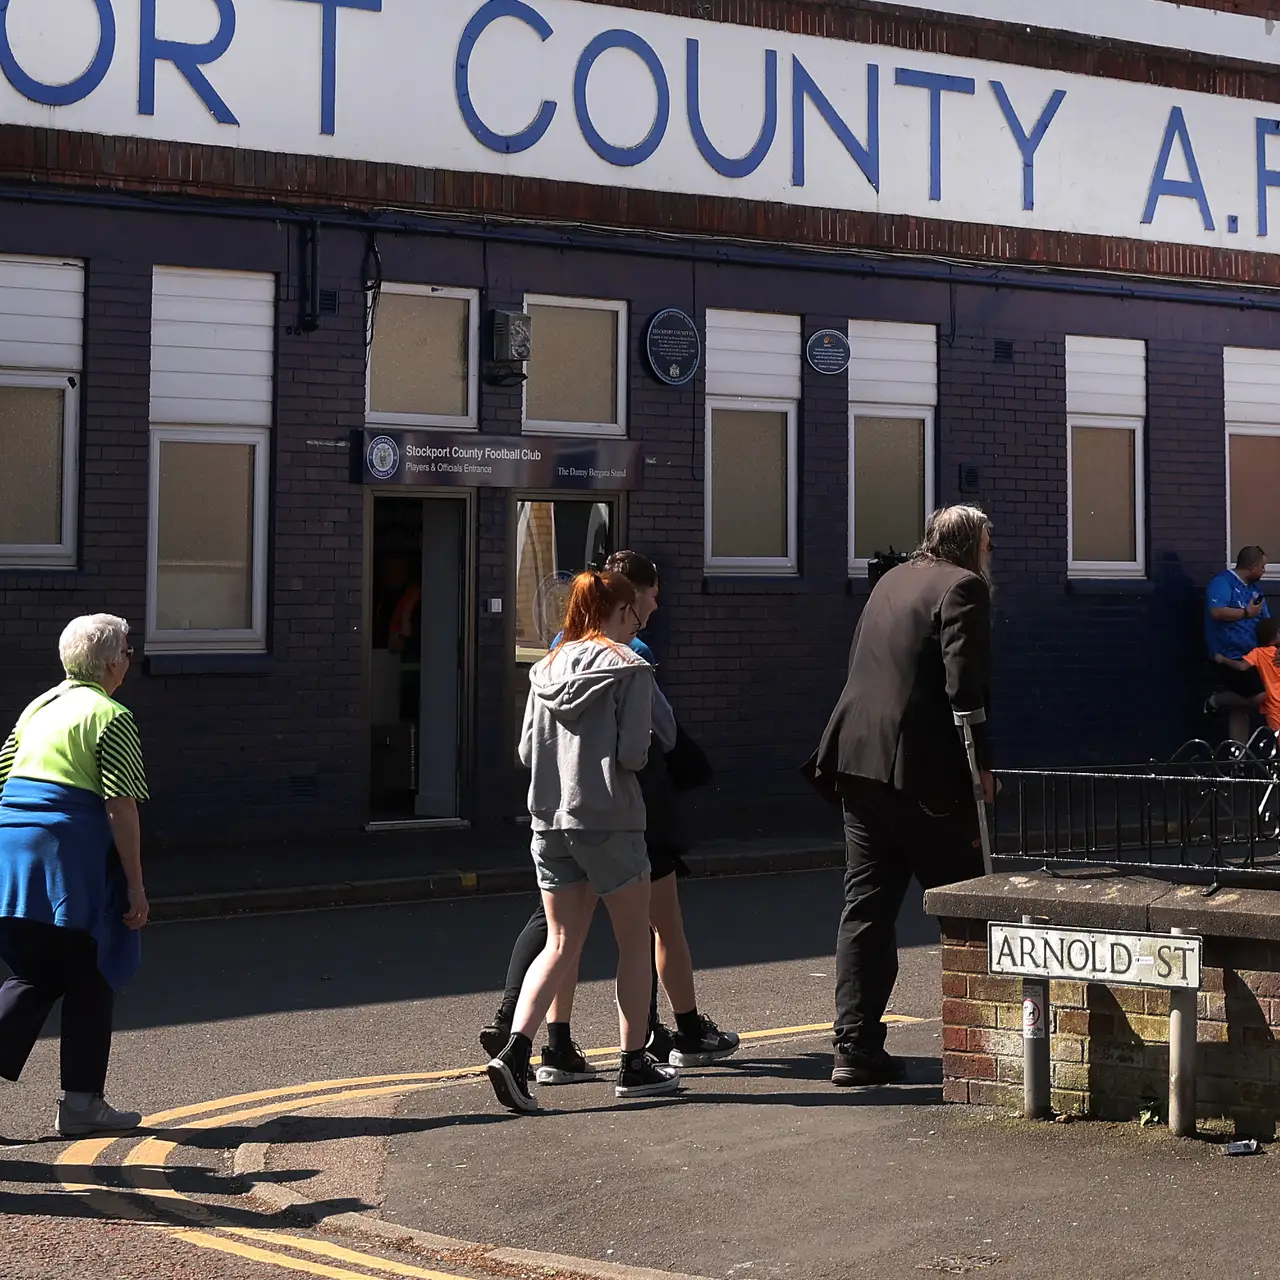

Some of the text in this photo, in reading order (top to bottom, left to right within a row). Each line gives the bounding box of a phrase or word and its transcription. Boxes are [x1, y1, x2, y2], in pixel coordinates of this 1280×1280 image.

[406, 444, 542, 461] Stockport County Football Club
[406, 462, 492, 474] Players & Officials Entrance
[558, 467, 627, 479] The Danny Bergara Stand
[995, 934, 1195, 980] ARNOLD ST
